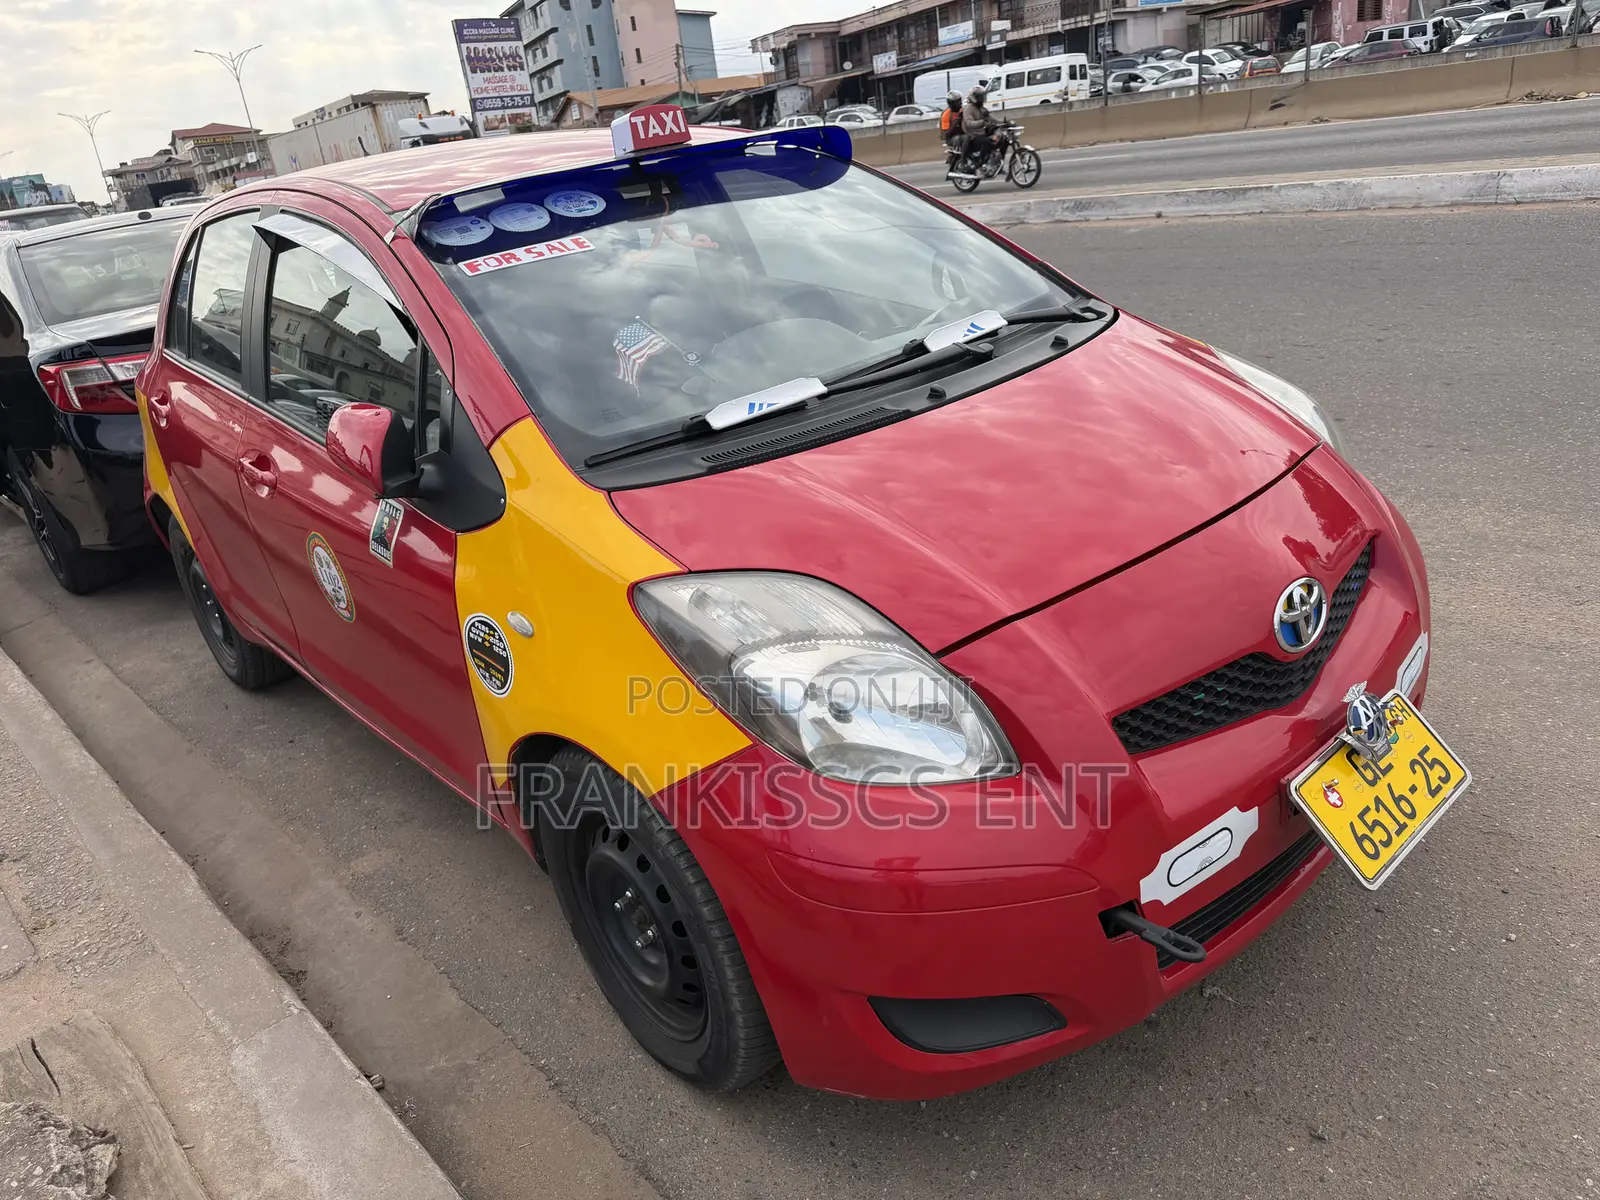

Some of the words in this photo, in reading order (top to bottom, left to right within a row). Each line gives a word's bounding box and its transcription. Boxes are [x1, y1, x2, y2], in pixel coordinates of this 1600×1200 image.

[479, 27, 500, 35] MASSAGE
[516, 84, 530, 92] CALL
[630, 110, 686, 139] TAXI
[463, 251, 523, 274] FOR
[524, 237, 592, 259] SALE
[475, 621, 490, 633] PERS
[1349, 744, 1451, 860] 6516-25
